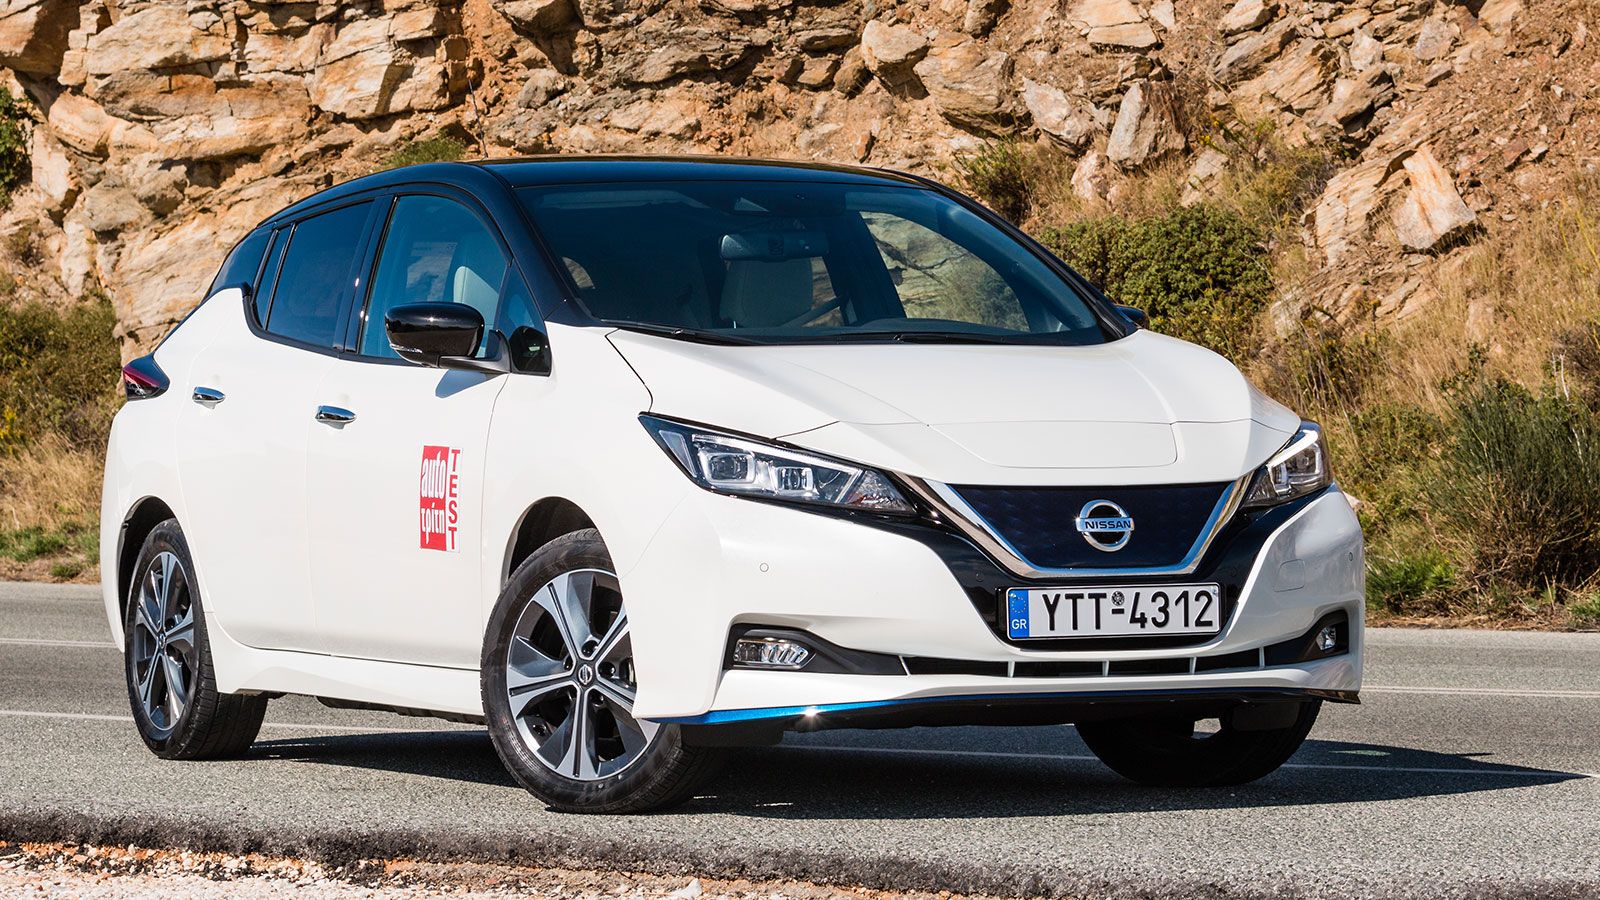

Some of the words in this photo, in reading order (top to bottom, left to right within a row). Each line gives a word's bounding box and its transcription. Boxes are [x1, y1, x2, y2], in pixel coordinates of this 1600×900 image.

[421, 450, 447, 500] auto
[448, 449, 461, 550] TEST
[1085, 520, 1131, 529] NISSAN
[1011, 619, 1027, 630] GR
